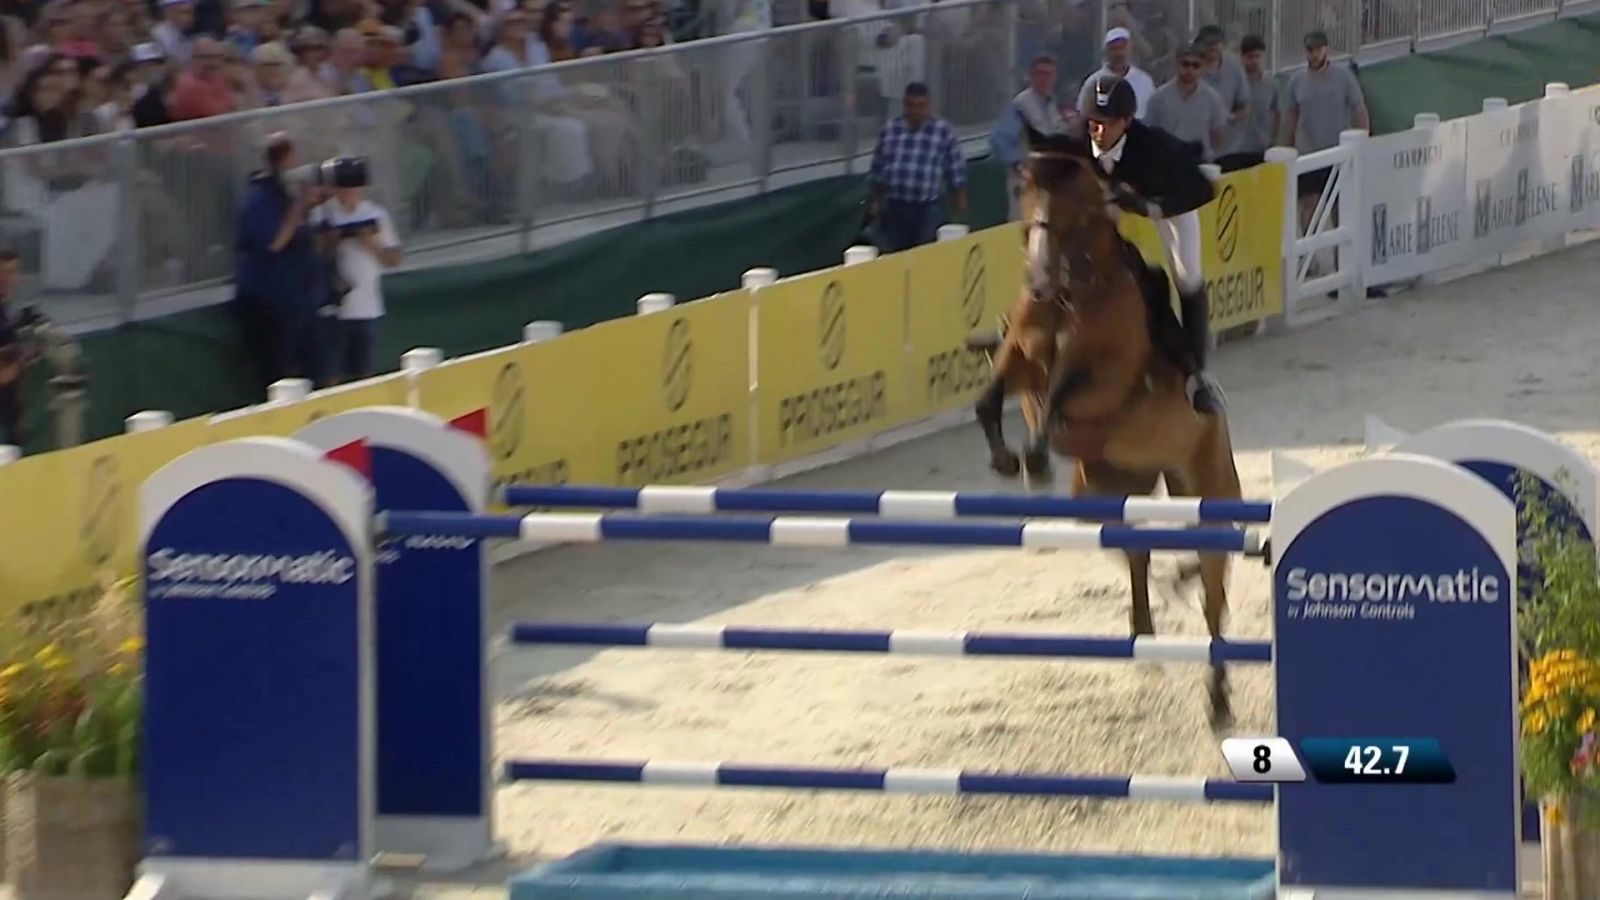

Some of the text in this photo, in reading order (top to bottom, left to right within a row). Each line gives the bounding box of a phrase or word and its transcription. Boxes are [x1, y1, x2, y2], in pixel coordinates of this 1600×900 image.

[1206, 265, 1265, 321] OSEGUR
[780, 370, 885, 444] PROSEGUR
[617, 413, 731, 486] PROSEGUR
[1287, 567, 1499, 602] Sensormatic
[1302, 601, 1356, 620] Johnson
[1360, 601, 1415, 620] Controls
